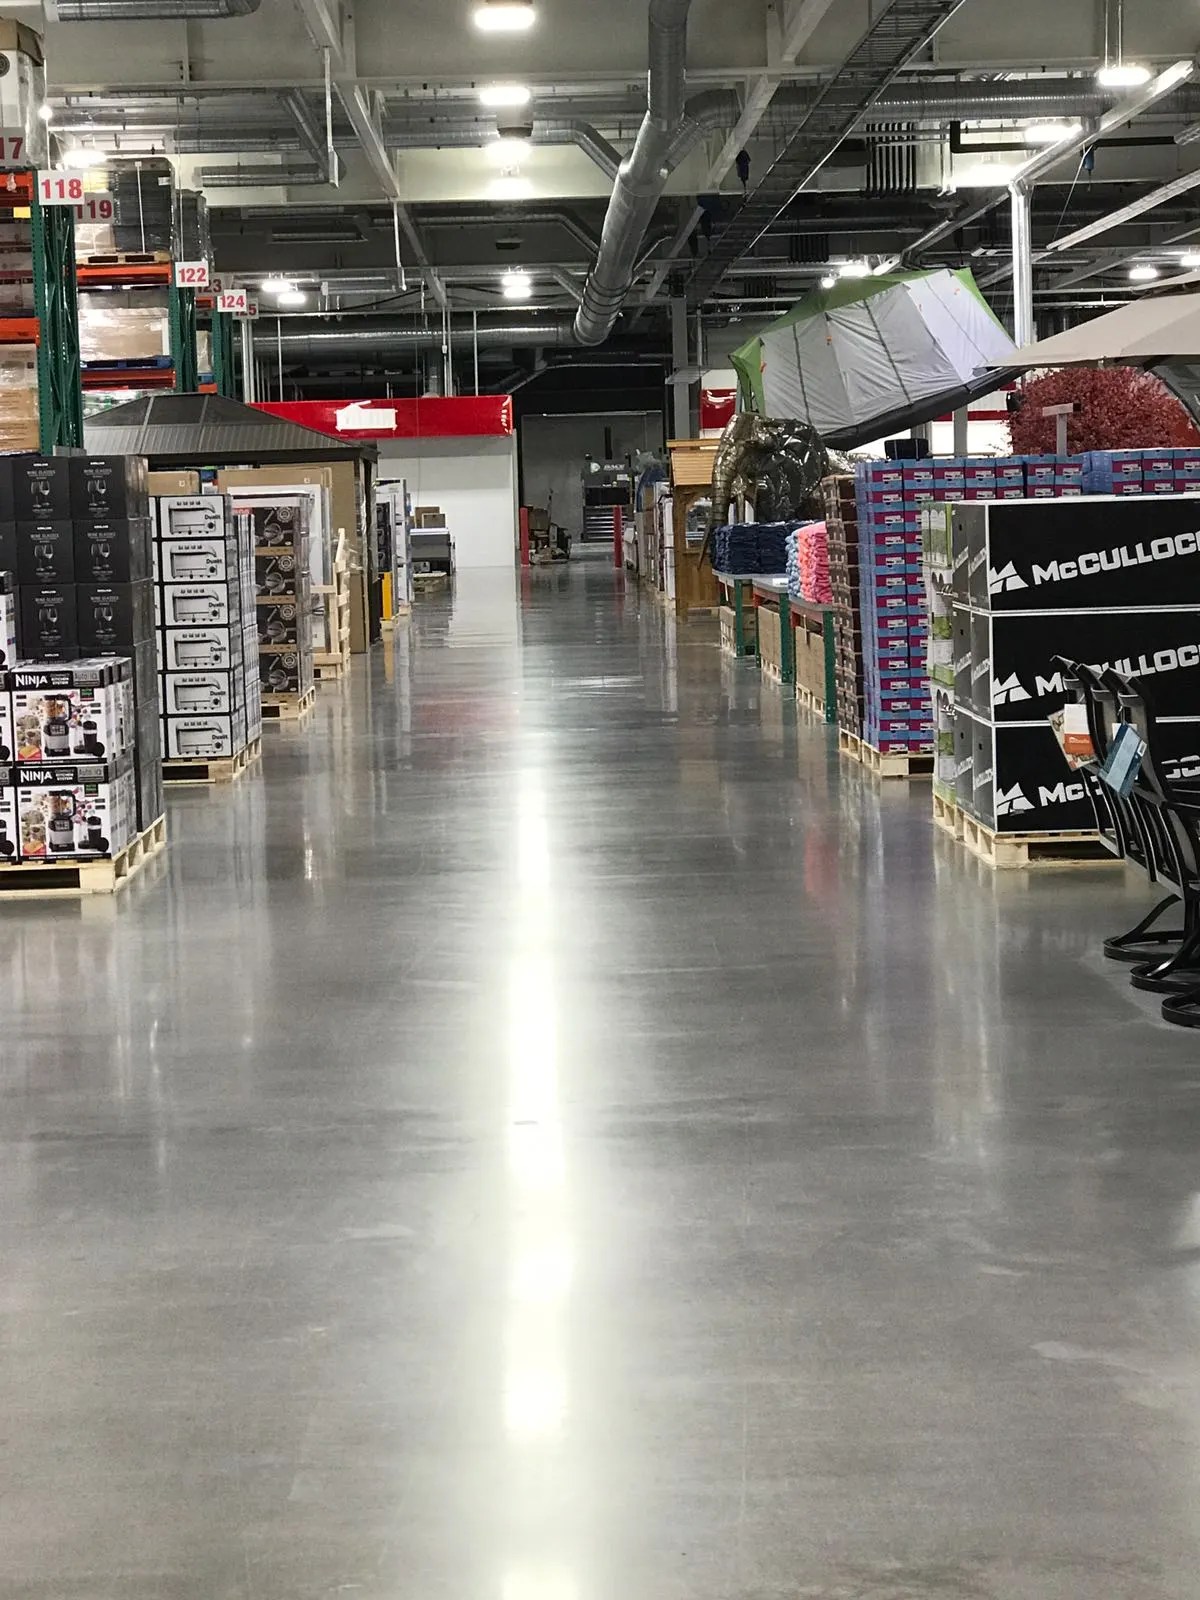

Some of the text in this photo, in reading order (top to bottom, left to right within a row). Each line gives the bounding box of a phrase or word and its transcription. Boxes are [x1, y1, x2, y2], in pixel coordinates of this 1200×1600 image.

[41, 178, 82, 199] 118
[178, 267, 207, 283] 122
[220, 295, 245, 308] 124
[1032, 530, 1200, 586] McCULLOC
[15, 673, 48, 688] NINJA
[20, 769, 52, 784] NINJA
